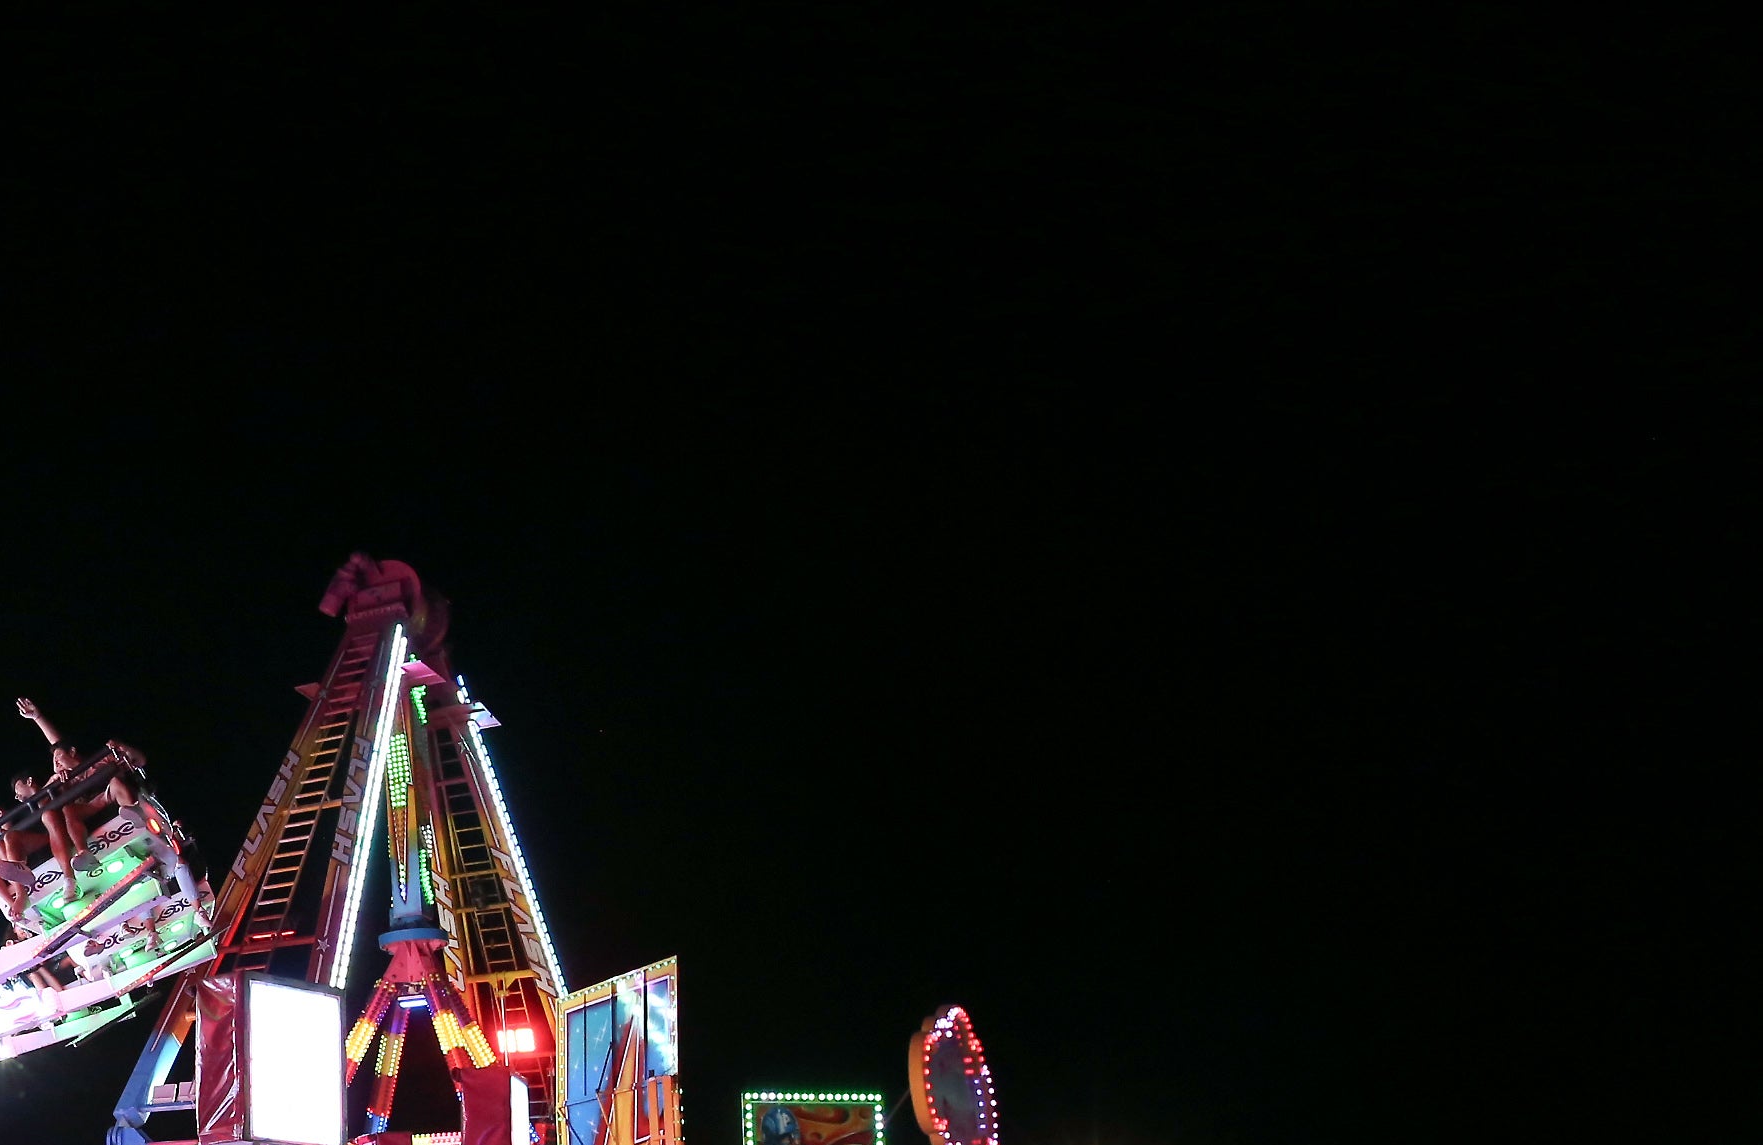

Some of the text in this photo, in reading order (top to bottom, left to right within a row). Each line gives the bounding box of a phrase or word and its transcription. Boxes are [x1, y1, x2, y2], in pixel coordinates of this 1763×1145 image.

[231, 749, 301, 880] FLASH
[431, 870, 466, 992] LASH
[490, 847, 558, 998] FLASH
